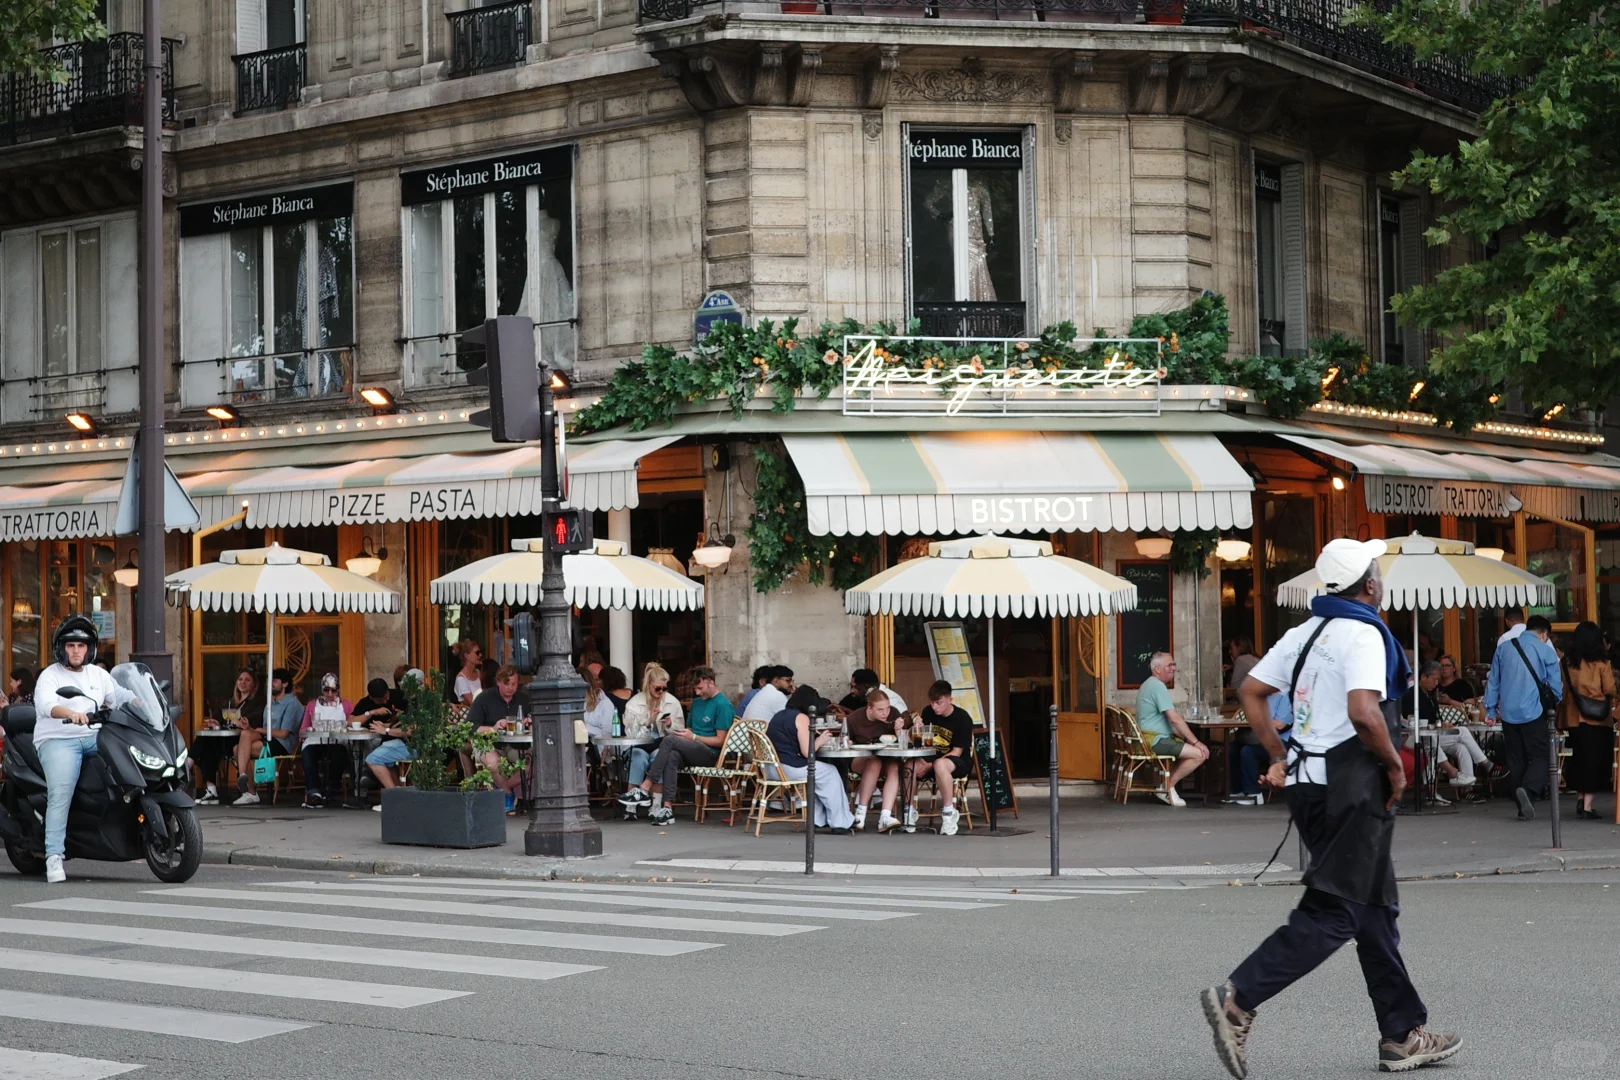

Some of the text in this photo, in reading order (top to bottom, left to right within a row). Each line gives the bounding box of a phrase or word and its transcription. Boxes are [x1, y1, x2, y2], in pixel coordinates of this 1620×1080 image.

[909, 138, 1020, 162] téphane Bianca
[426, 161, 542, 194] Stéphane Bianca
[212, 196, 314, 225] Stéphane Bianca
[846, 339, 1159, 416] Marguerite
[328, 488, 476, 517] PIZZE PASTA
[971, 496, 1093, 523] BISTROT
[1384, 483, 1504, 511] BISTROT TRATTORIA
[2, 510, 99, 536] TRATTORIA
